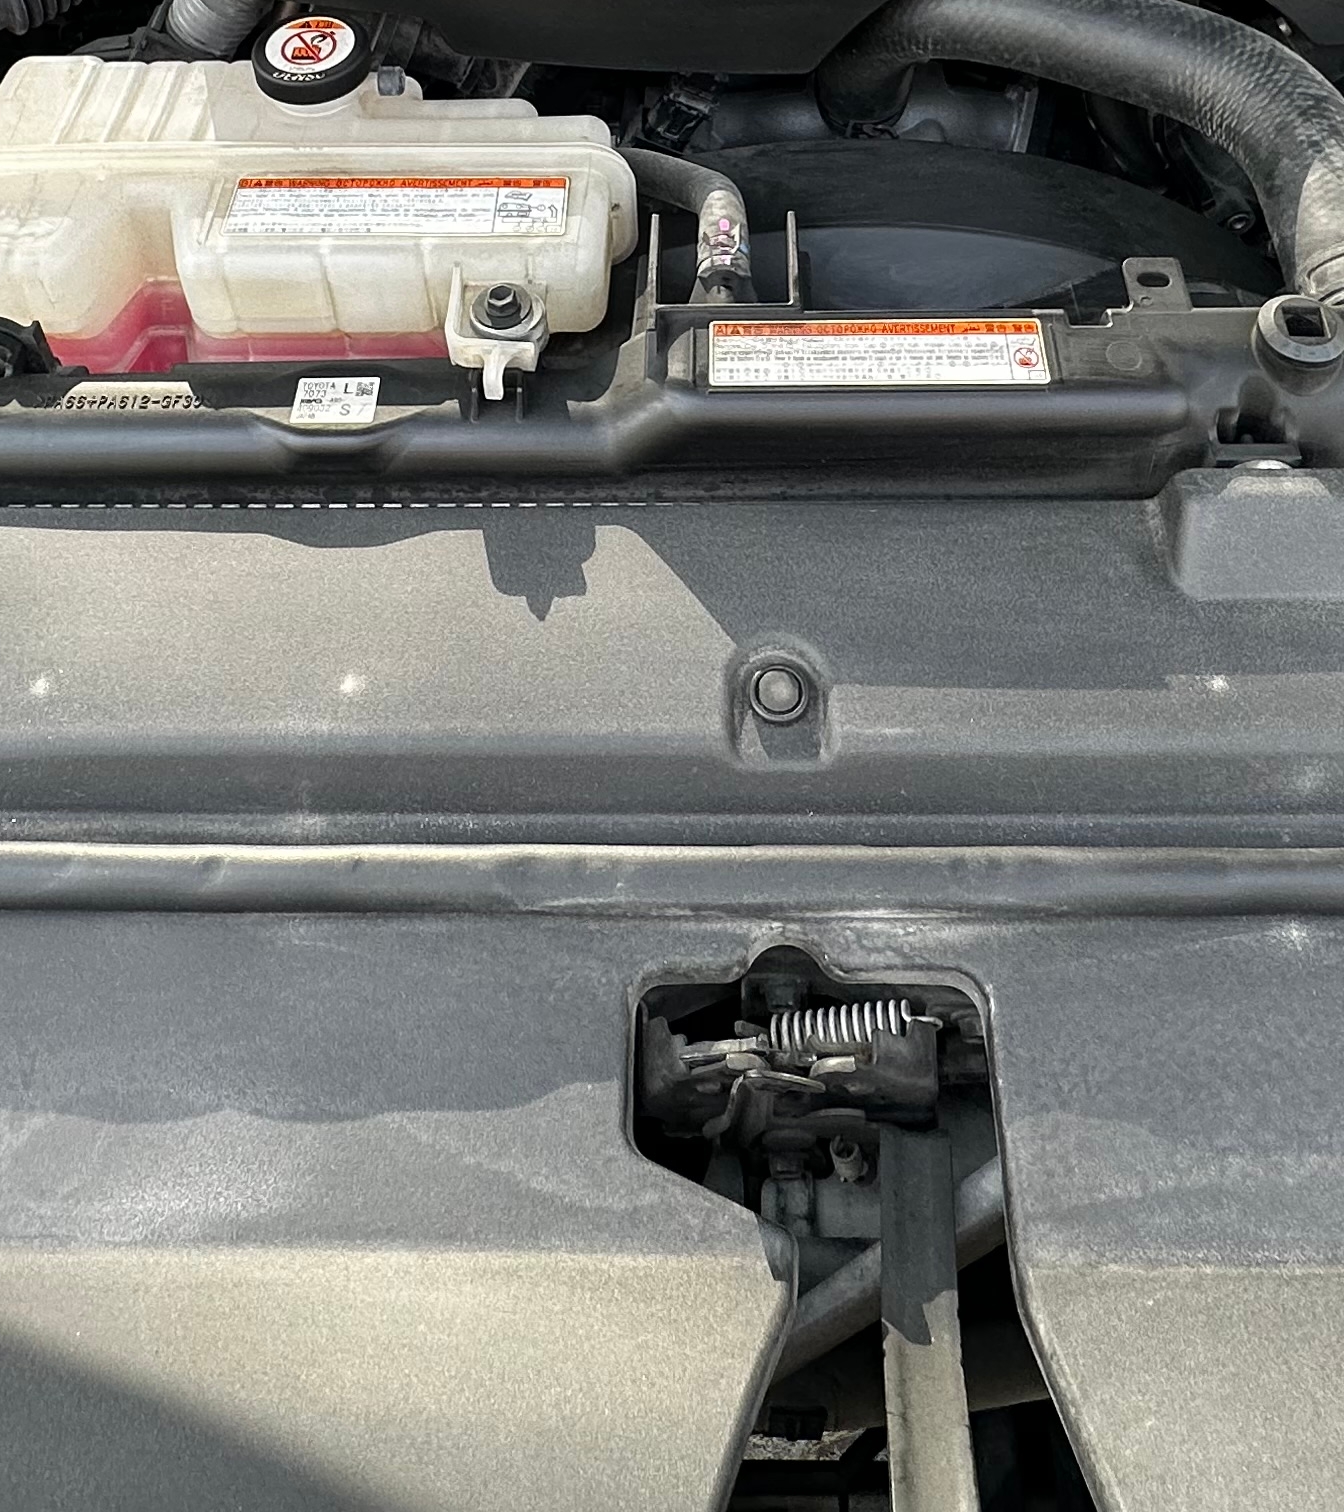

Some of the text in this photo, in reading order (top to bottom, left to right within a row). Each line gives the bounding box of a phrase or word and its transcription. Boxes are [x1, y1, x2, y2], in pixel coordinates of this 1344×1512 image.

[400, 179, 473, 187] AVERTISSEMENT
[881, 323, 956, 333] AVERTISSEMENT
[303, 381, 336, 390] TOYOTA
